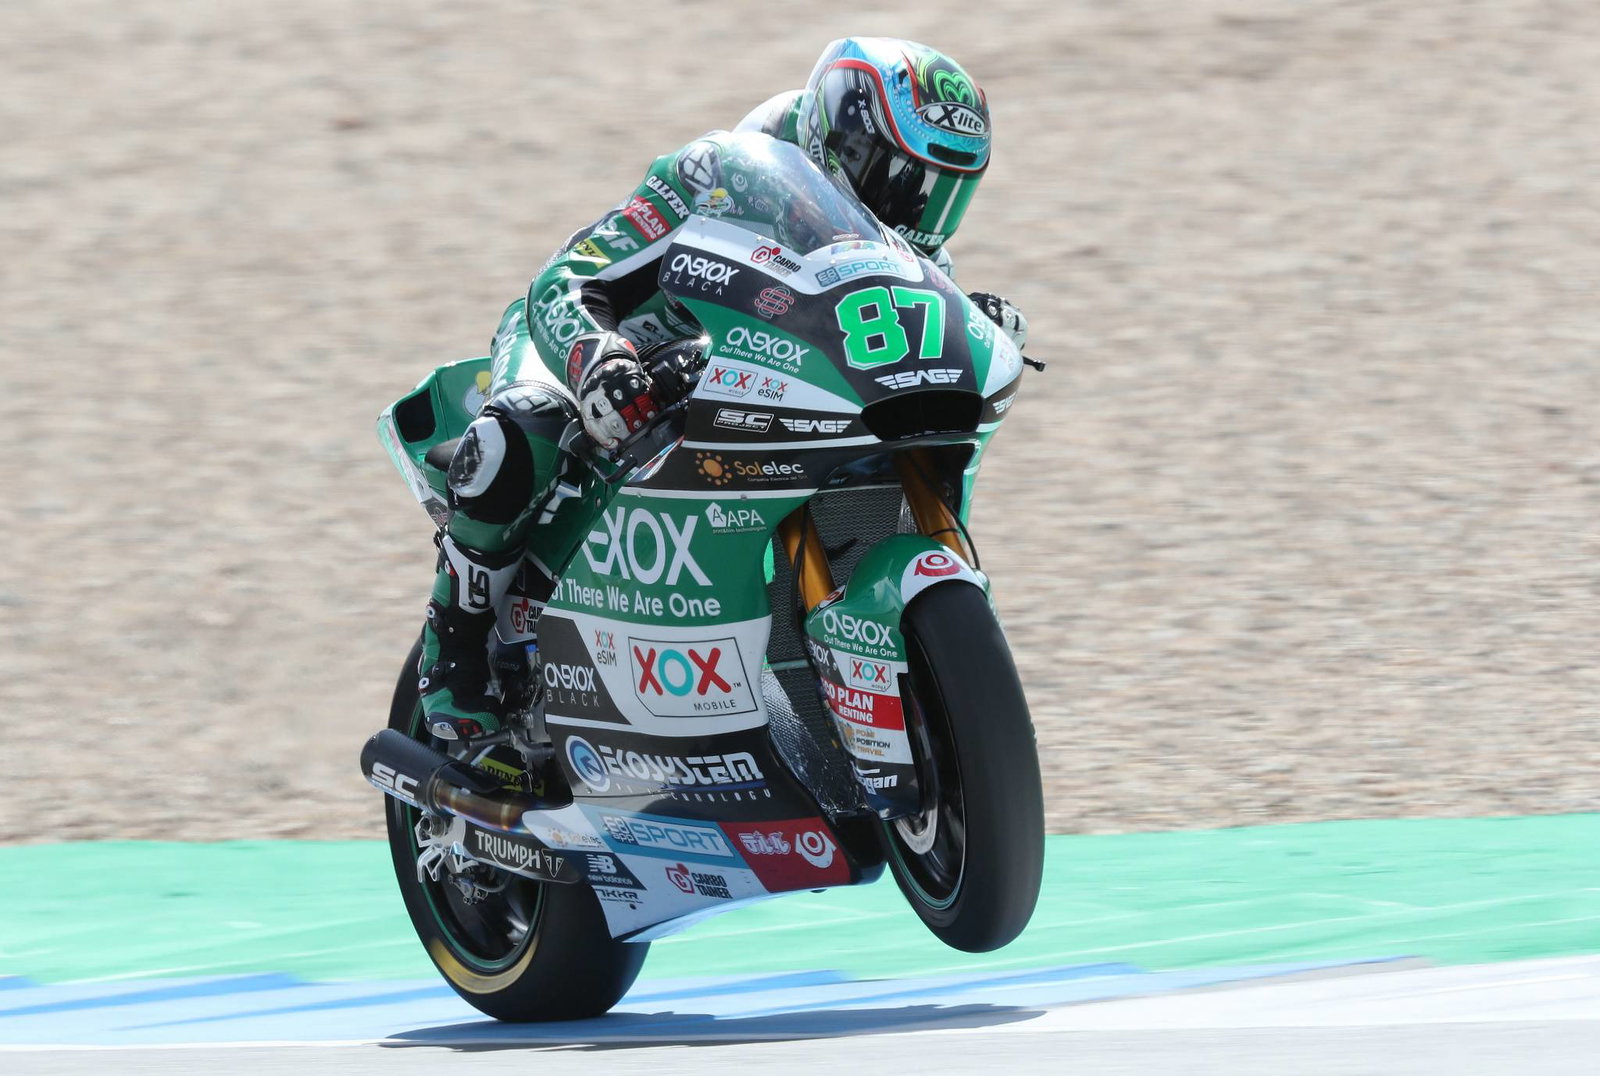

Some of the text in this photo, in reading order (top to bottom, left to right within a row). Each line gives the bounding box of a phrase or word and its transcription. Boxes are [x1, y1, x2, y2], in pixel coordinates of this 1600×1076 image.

[924, 105, 982, 132] X-lite
[646, 175, 690, 220] GALFER
[894, 224, 945, 246] GALFER
[671, 253, 740, 286] ONEXOX
[773, 255, 801, 273] CARBO
[838, 260, 900, 277] SPORT
[834, 286, 946, 371] 87
[726, 327, 810, 366] ONEXOX
[719, 345, 800, 374] Out There We Are One
[709, 367, 752, 389] XOX
[762, 376, 788, 392] XOX
[757, 388, 784, 402] eSIM
[719, 411, 771, 426] SC
[734, 460, 804, 475] Solelec
[727, 509, 765, 527] APA
[566, 579, 604, 609] There
[607, 585, 629, 614] We
[633, 590, 664, 618] Are
[668, 593, 721, 618] One
[595, 629, 615, 650] XOX
[823, 609, 896, 648] ONEXOX
[824, 634, 898, 658] Out There We Are One
[597, 650, 618, 666] eSIM
[544, 662, 597, 692] ONEXOX
[632, 645, 732, 697] XOX
[852, 660, 886, 684] XOX
[546, 689, 600, 708] BLACK
[693, 699, 737, 711] MOBILE
[837, 688, 873, 711] PLAN
[838, 705, 873, 724] RENTING
[856, 737, 891, 749] POSITION
[371, 761, 419, 799] SC
[629, 822, 720, 851] SPORT
[474, 829, 541, 871] TRIUMPH
[692, 872, 727, 888] CARBO
[694, 883, 733, 899] TAINER
